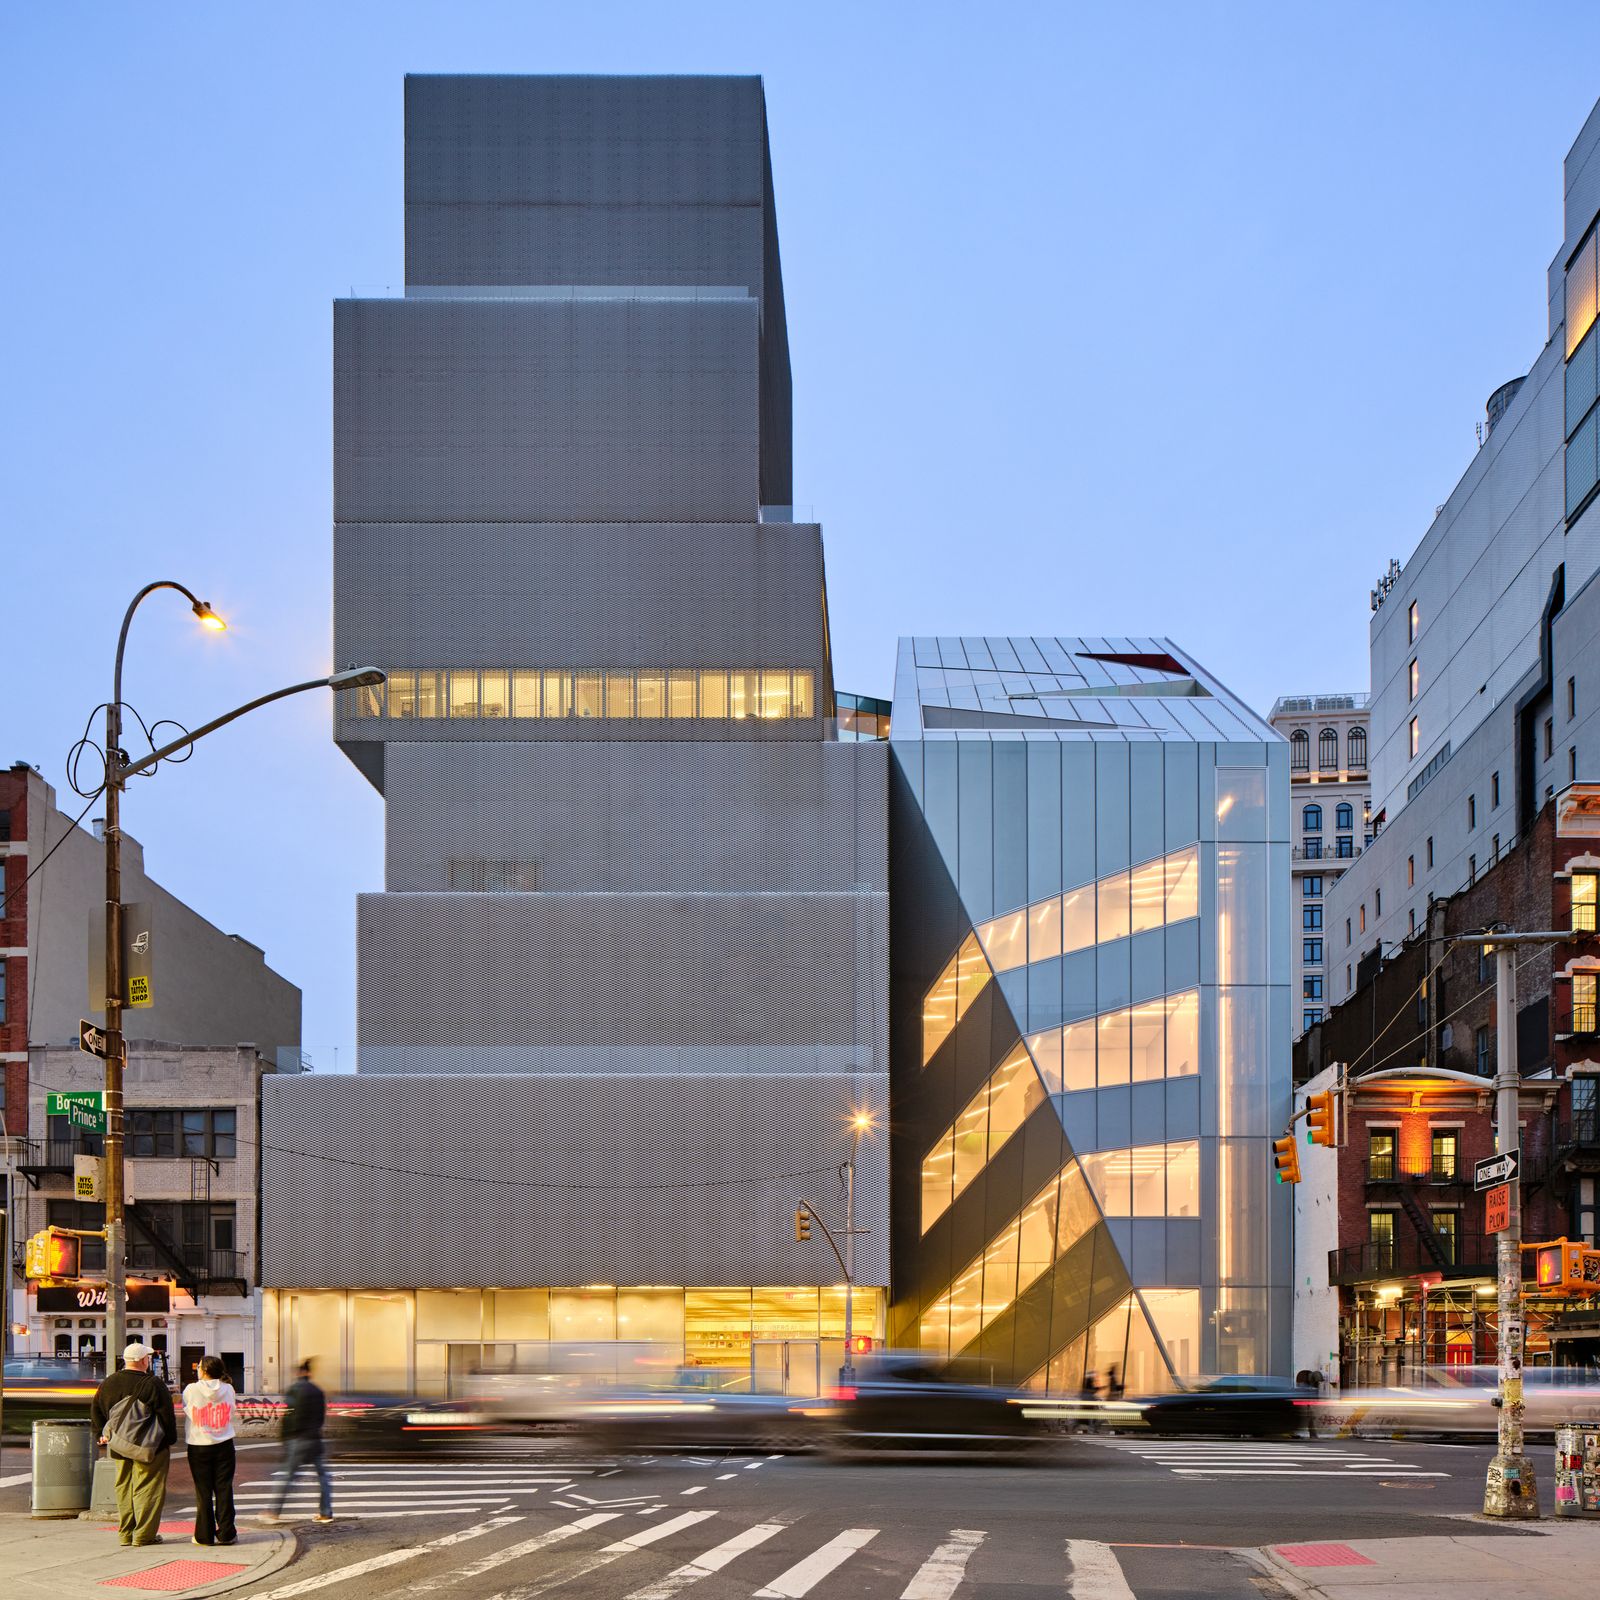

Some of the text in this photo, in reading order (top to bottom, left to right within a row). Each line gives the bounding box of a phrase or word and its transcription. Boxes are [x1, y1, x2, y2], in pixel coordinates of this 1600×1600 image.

[132, 978, 145, 986] NYC
[131, 985, 147, 994] TATTOO
[131, 994, 148, 1002] SHOP
[73, 1105, 104, 1128] Prince St
[1480, 1161, 1510, 1181] ONE WAY
[78, 1182, 94, 1190] TATTOO
[1489, 1190, 1506, 1208] RAISE
[1489, 1211, 1506, 1229] PLOW
